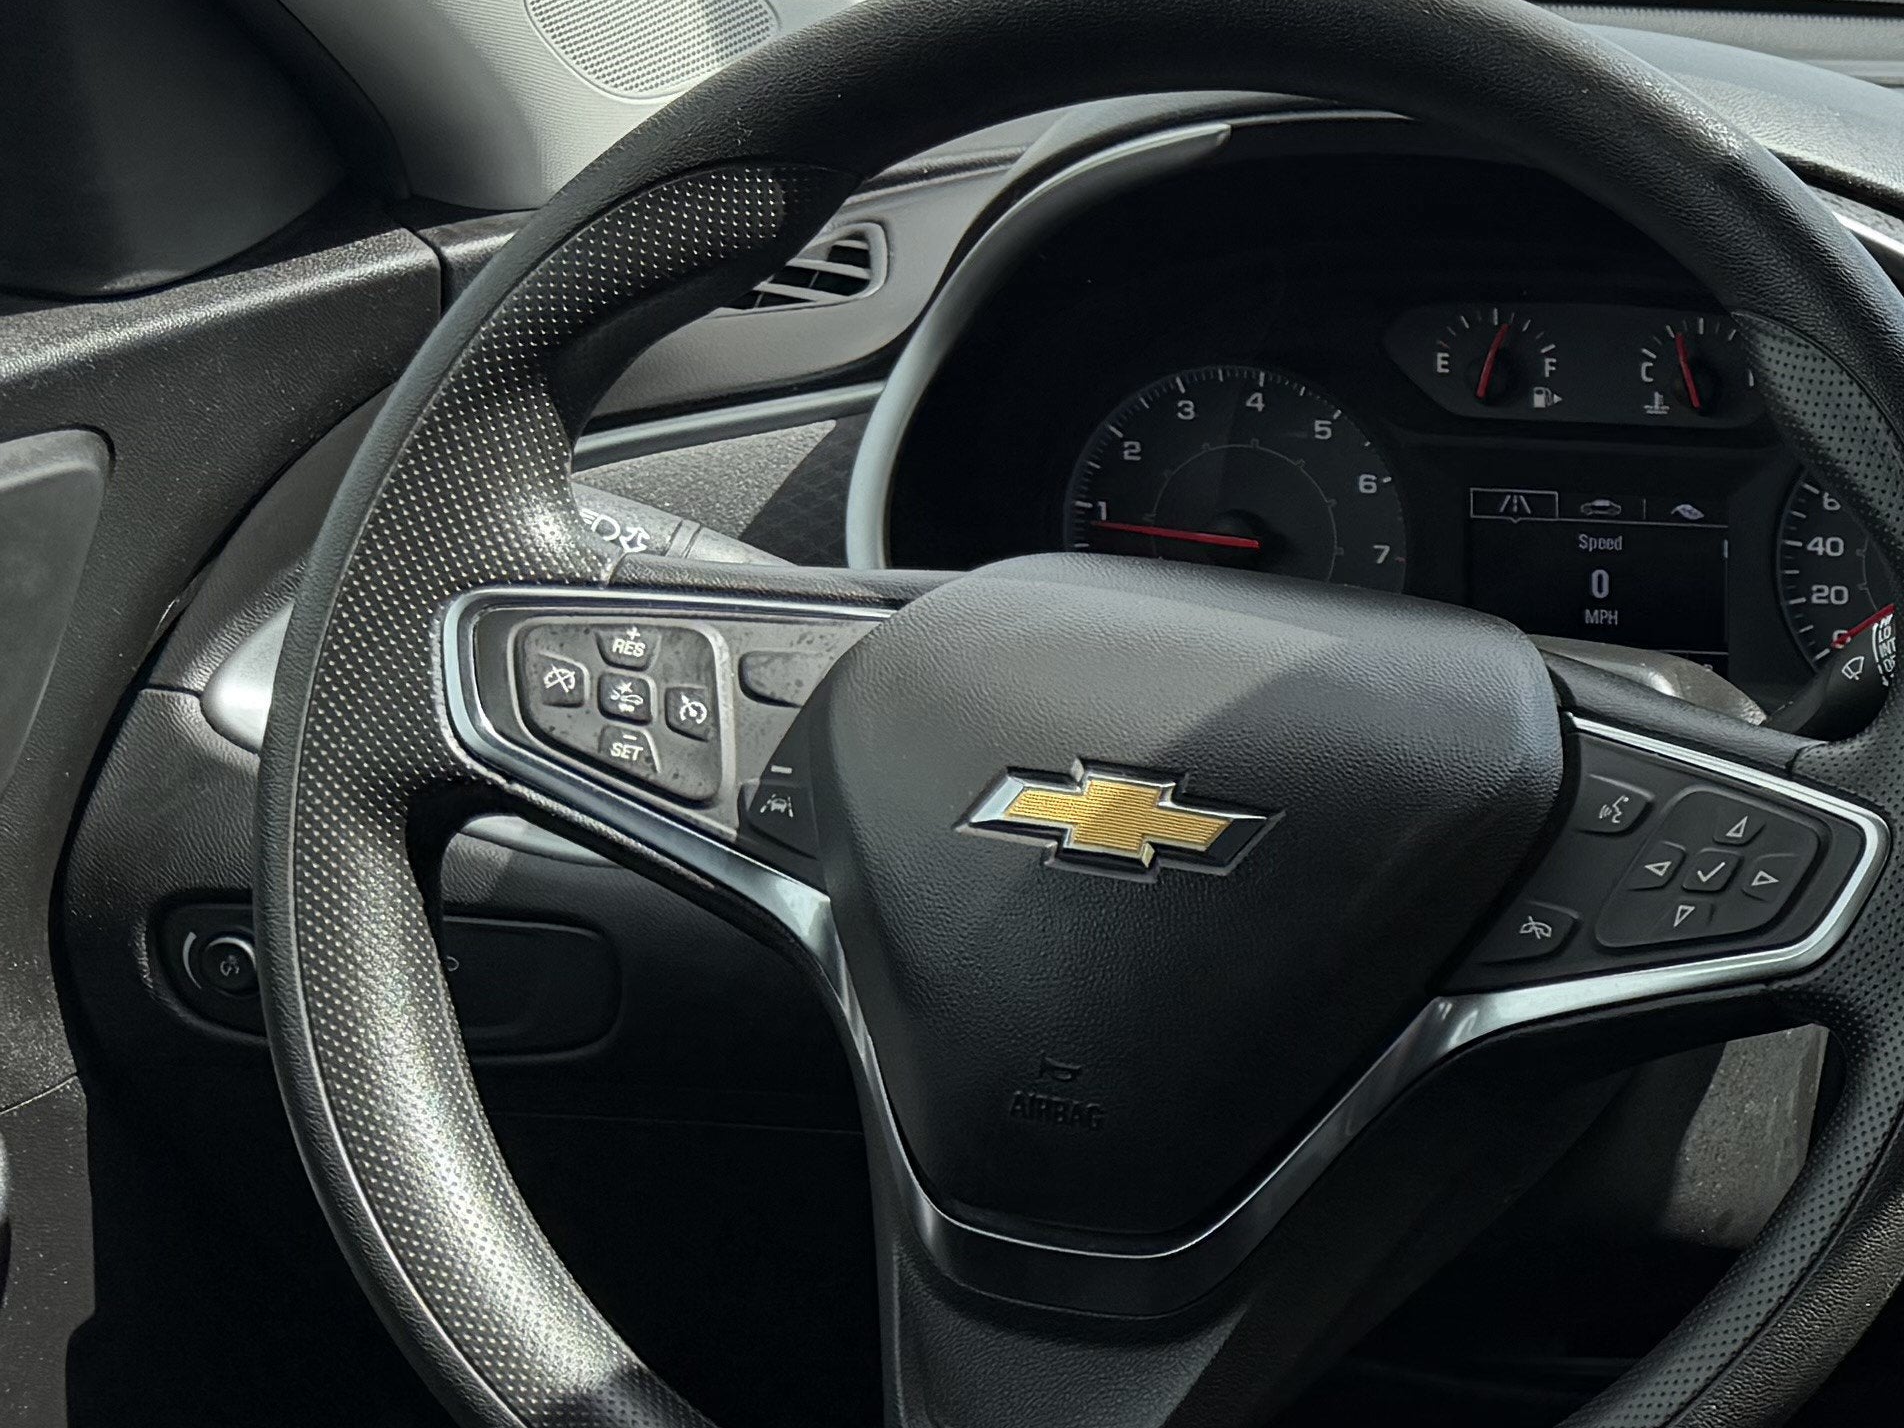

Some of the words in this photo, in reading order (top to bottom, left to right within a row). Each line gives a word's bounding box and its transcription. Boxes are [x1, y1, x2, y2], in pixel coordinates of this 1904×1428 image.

[1436, 352, 1450, 373] E
[1545, 357, 1557, 378] F
[1641, 362, 1654, 383] C
[1176, 400, 1196, 420] 3
[1245, 392, 1265, 412] 4
[1314, 420, 1332, 440] 5
[1123, 441, 1142, 461] 2
[1358, 474, 1378, 494] 6
[1097, 501, 1107, 521] 1
[1578, 533, 1623, 552] Speed
[1806, 536, 1845, 557] 40
[1373, 545, 1390, 564] 7
[1591, 569, 1610, 599] 0
[1810, 584, 1849, 605] 20
[1585, 609, 1619, 626] MPH
[612, 639, 646, 659] RES
[610, 743, 643, 762] SET
